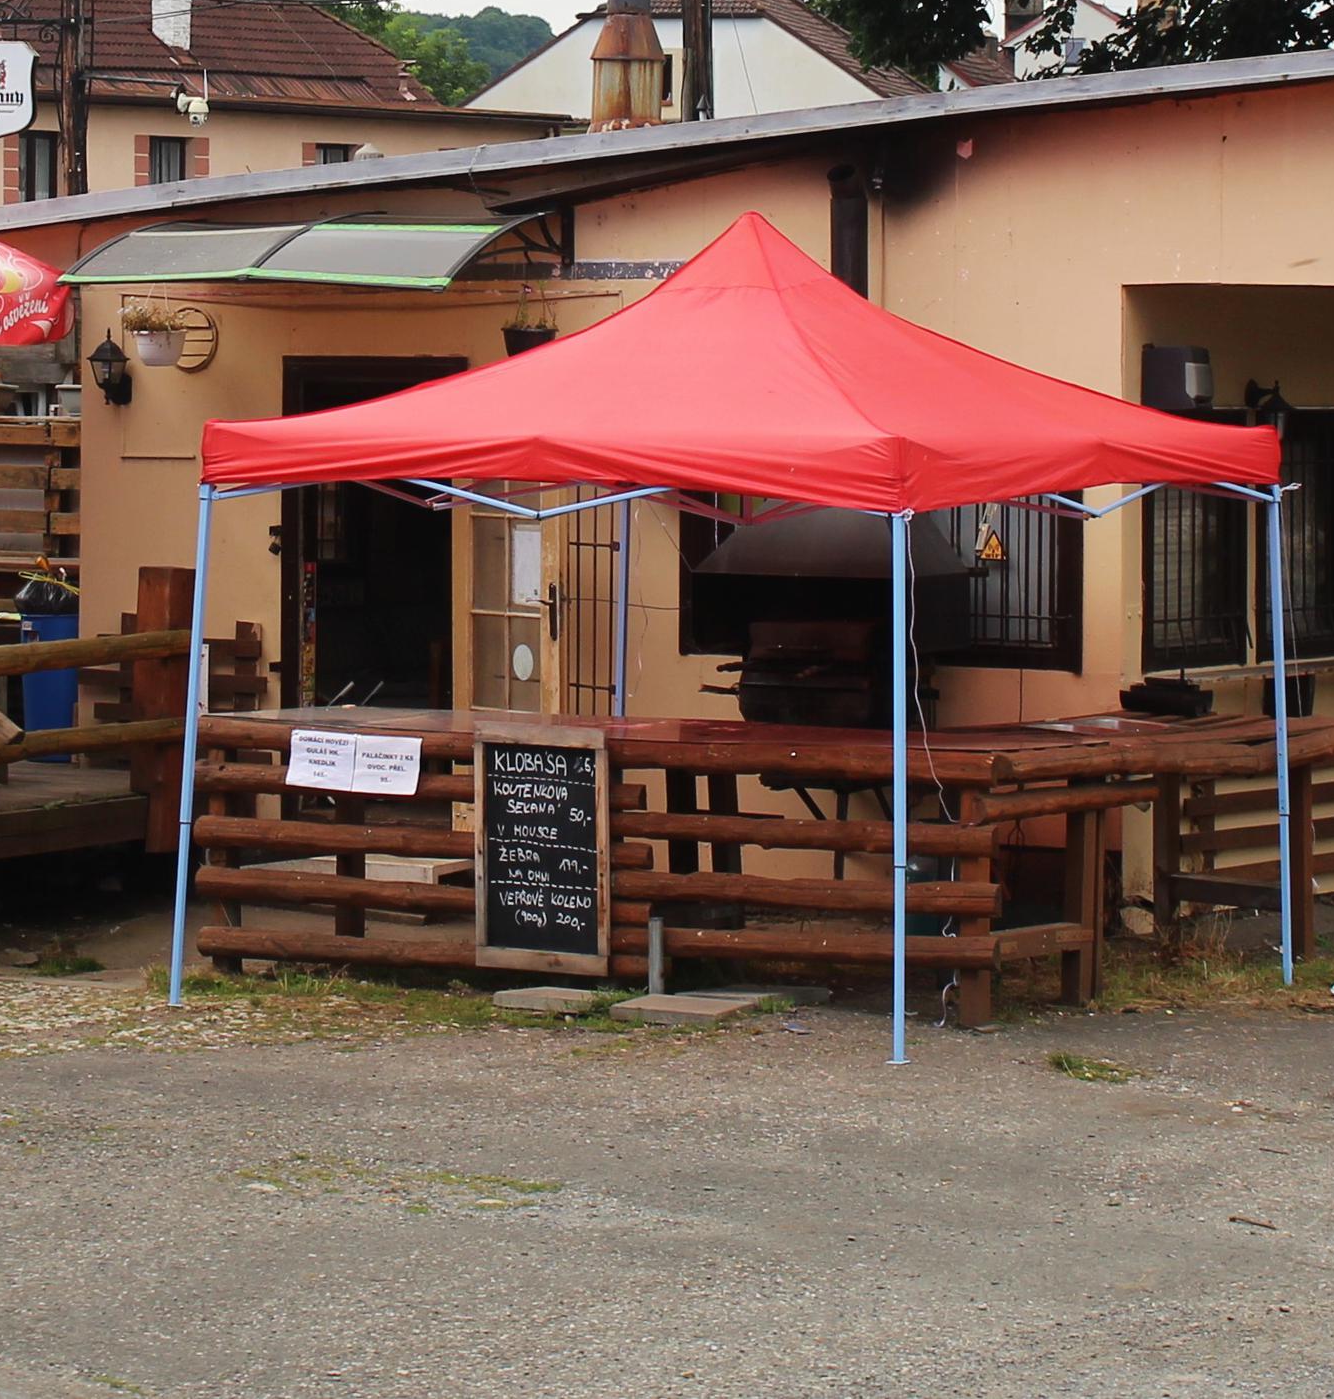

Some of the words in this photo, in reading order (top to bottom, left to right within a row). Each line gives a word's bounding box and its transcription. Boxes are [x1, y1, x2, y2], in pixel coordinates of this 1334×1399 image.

[3, 292, 49, 331] osvěžení
[497, 823, 505, 836] V
[514, 824, 558, 840] HOUSCE
[499, 845, 541, 863] ŽEBRA
[508, 868, 523, 879] NA
[527, 870, 550, 882] OHNI
[499, 888, 545, 908] VEPŘOVÉ
[550, 892, 592, 909] KOLENO
